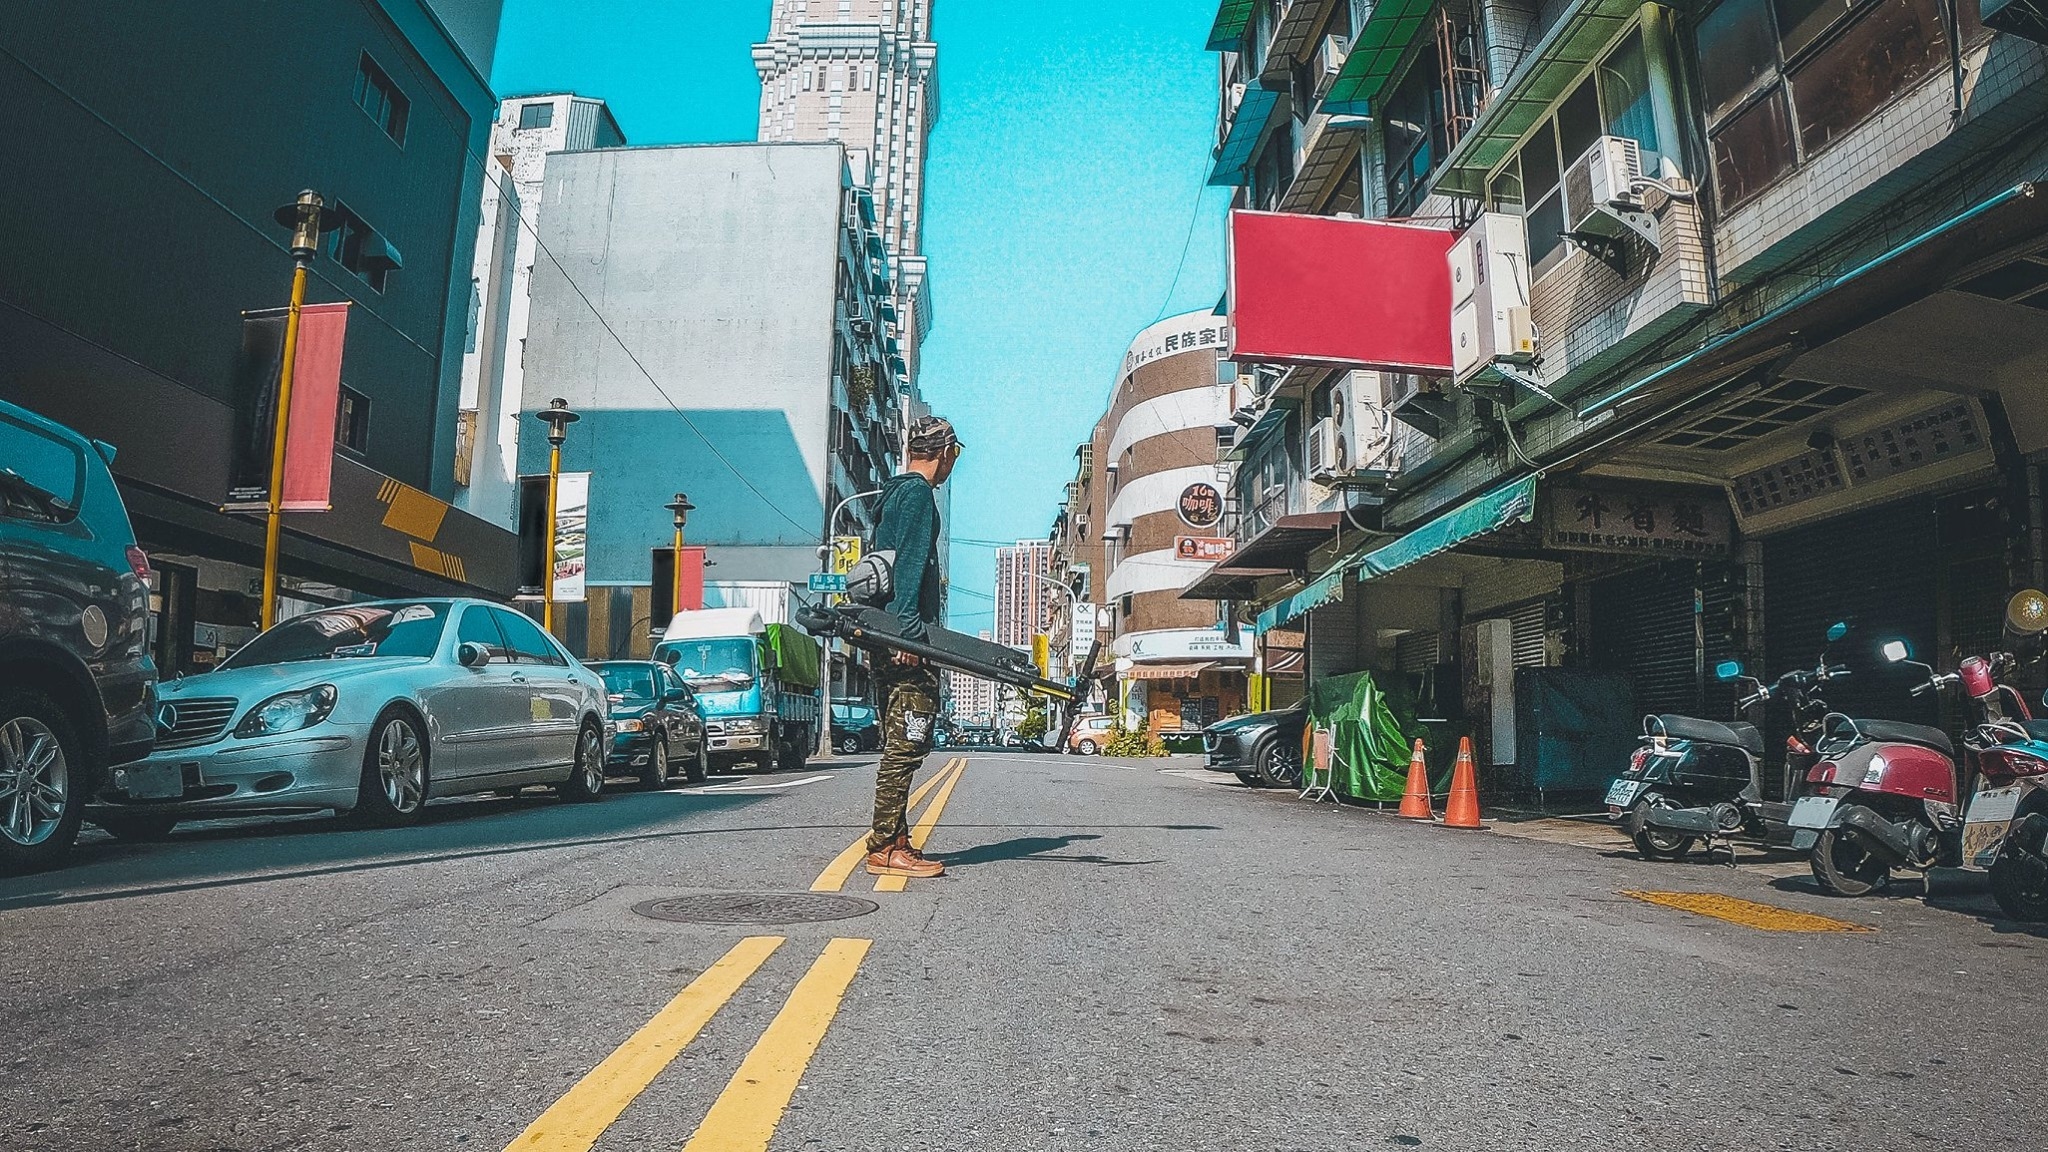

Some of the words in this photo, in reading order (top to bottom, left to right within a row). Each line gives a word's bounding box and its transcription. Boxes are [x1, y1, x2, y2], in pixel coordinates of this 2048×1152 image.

[1182, 495, 1214, 513] 咖啡
[1575, 494, 1710, 537] 外省麵
